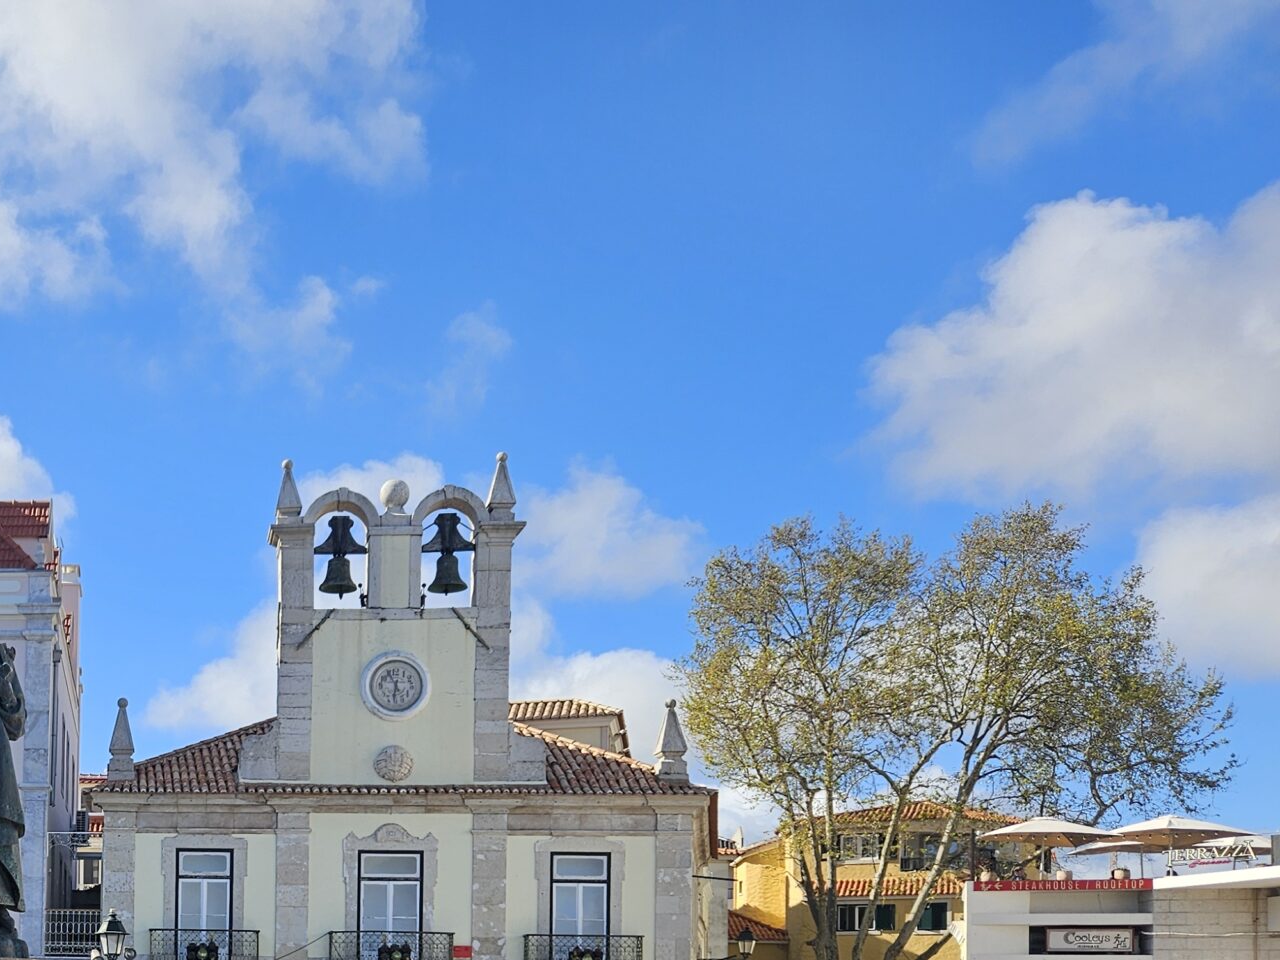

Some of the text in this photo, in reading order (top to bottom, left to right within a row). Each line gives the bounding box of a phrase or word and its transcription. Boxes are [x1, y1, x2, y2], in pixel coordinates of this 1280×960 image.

[1162, 840, 1258, 867] TERRAZZA
[1011, 881, 1080, 890] STEAKHOUSE
[1095, 880, 1144, 889] ROOFTOP
